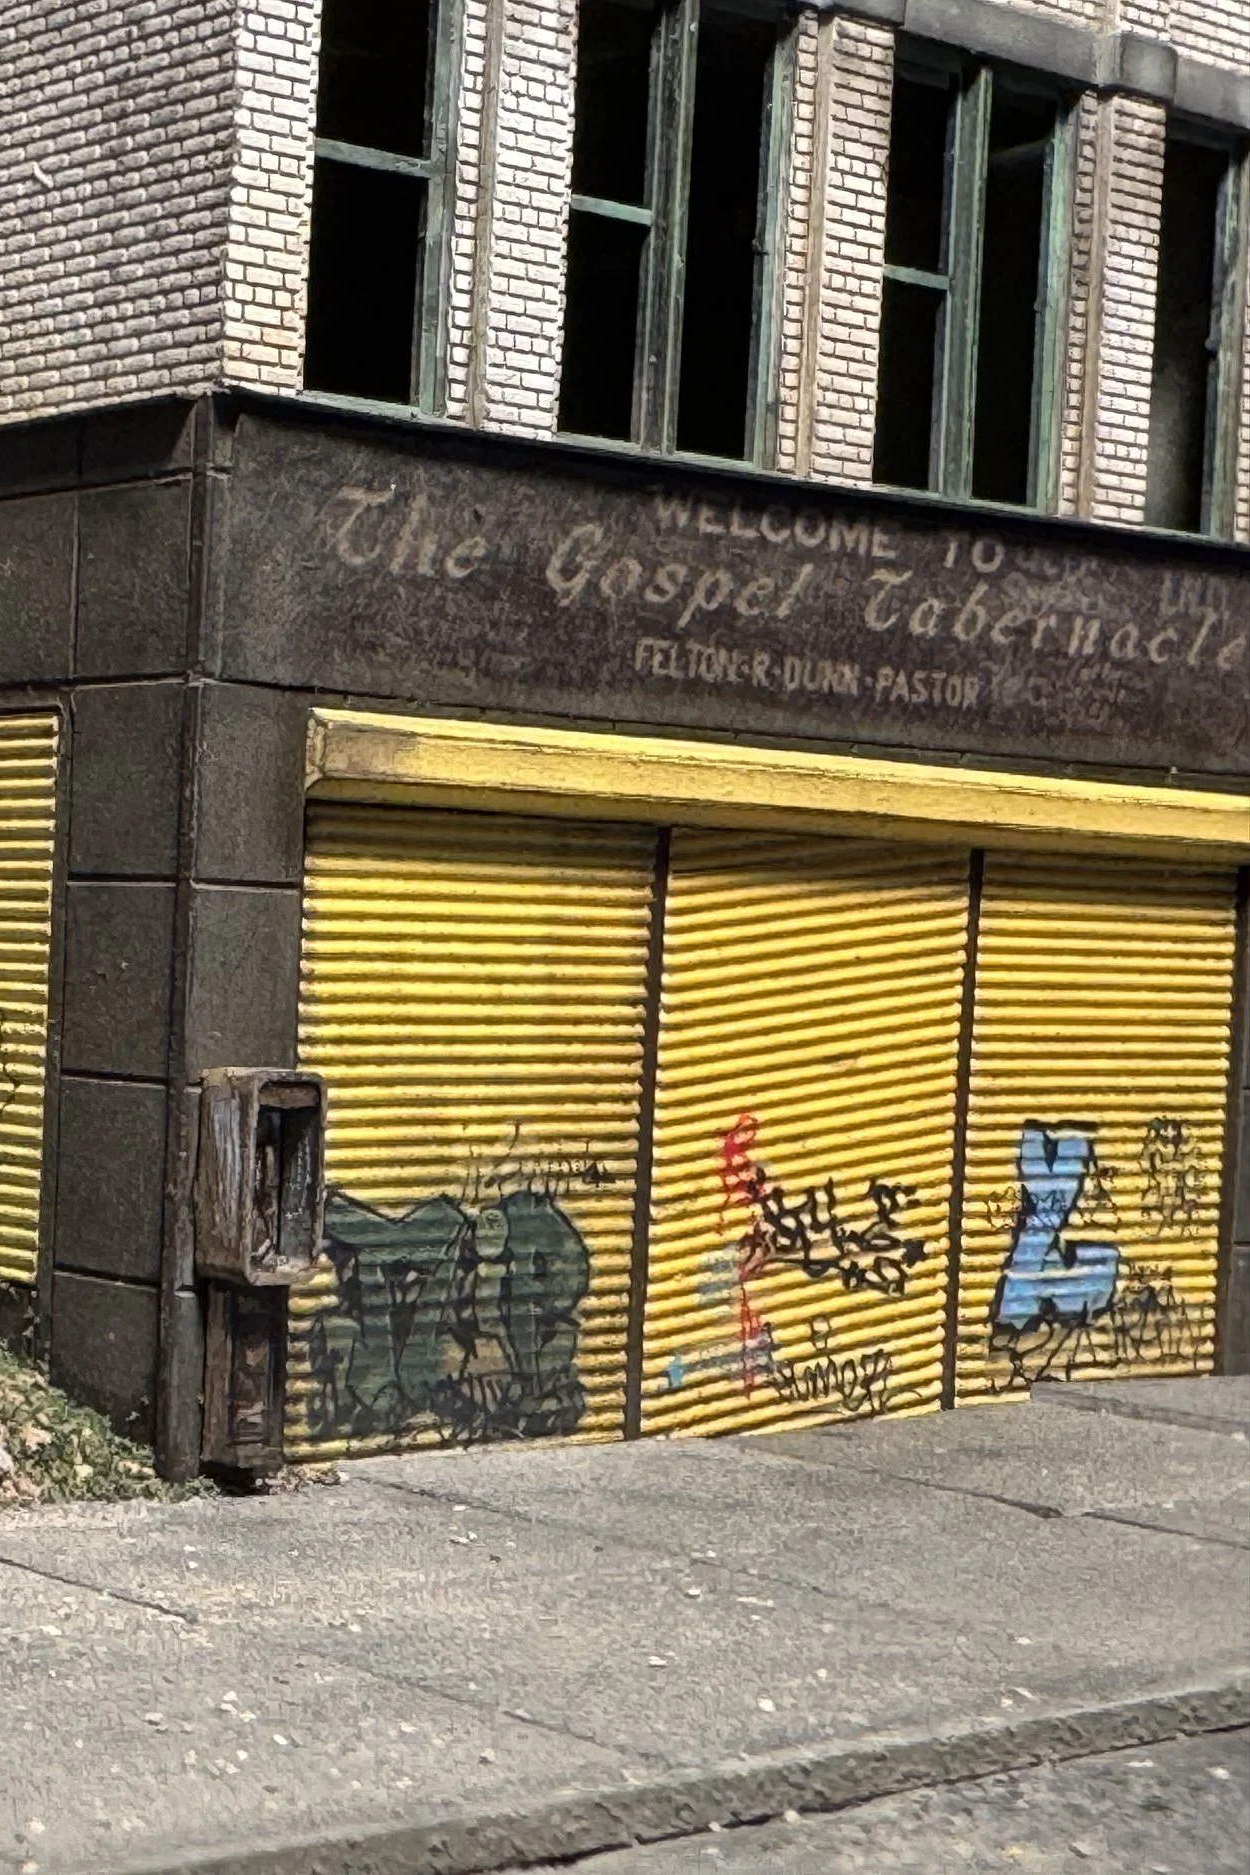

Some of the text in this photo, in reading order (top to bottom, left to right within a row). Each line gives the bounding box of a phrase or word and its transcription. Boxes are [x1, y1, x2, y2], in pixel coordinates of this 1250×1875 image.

[329, 484, 488, 579] The
[546, 522, 814, 630] Gospel
[865, 565, 1247, 671] Tabernacle
[655, 499, 897, 559] WELCOME
